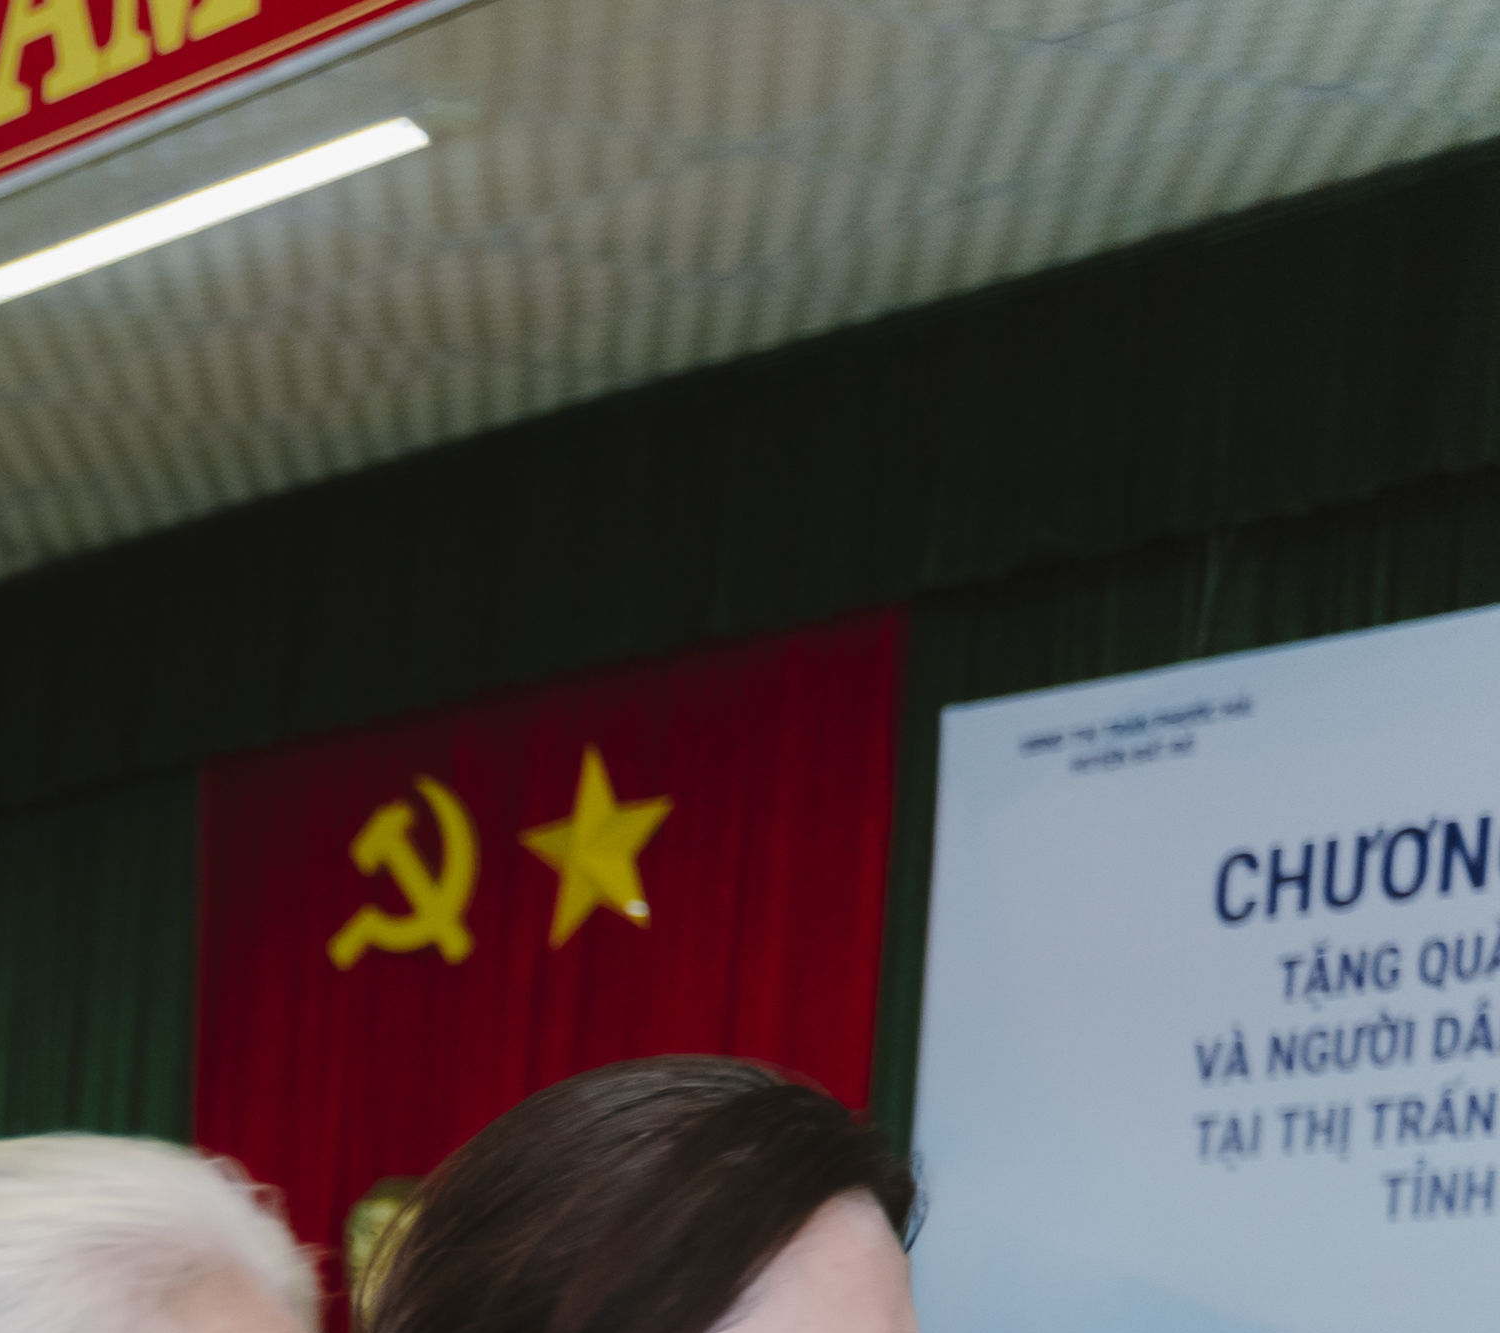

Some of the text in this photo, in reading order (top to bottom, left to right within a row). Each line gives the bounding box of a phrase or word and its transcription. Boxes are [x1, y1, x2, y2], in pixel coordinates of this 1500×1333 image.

[1214, 815, 1500, 923] CHƯƠN
[1194, 998, 1500, 1081] VÀ NGƯỜI DÂ
